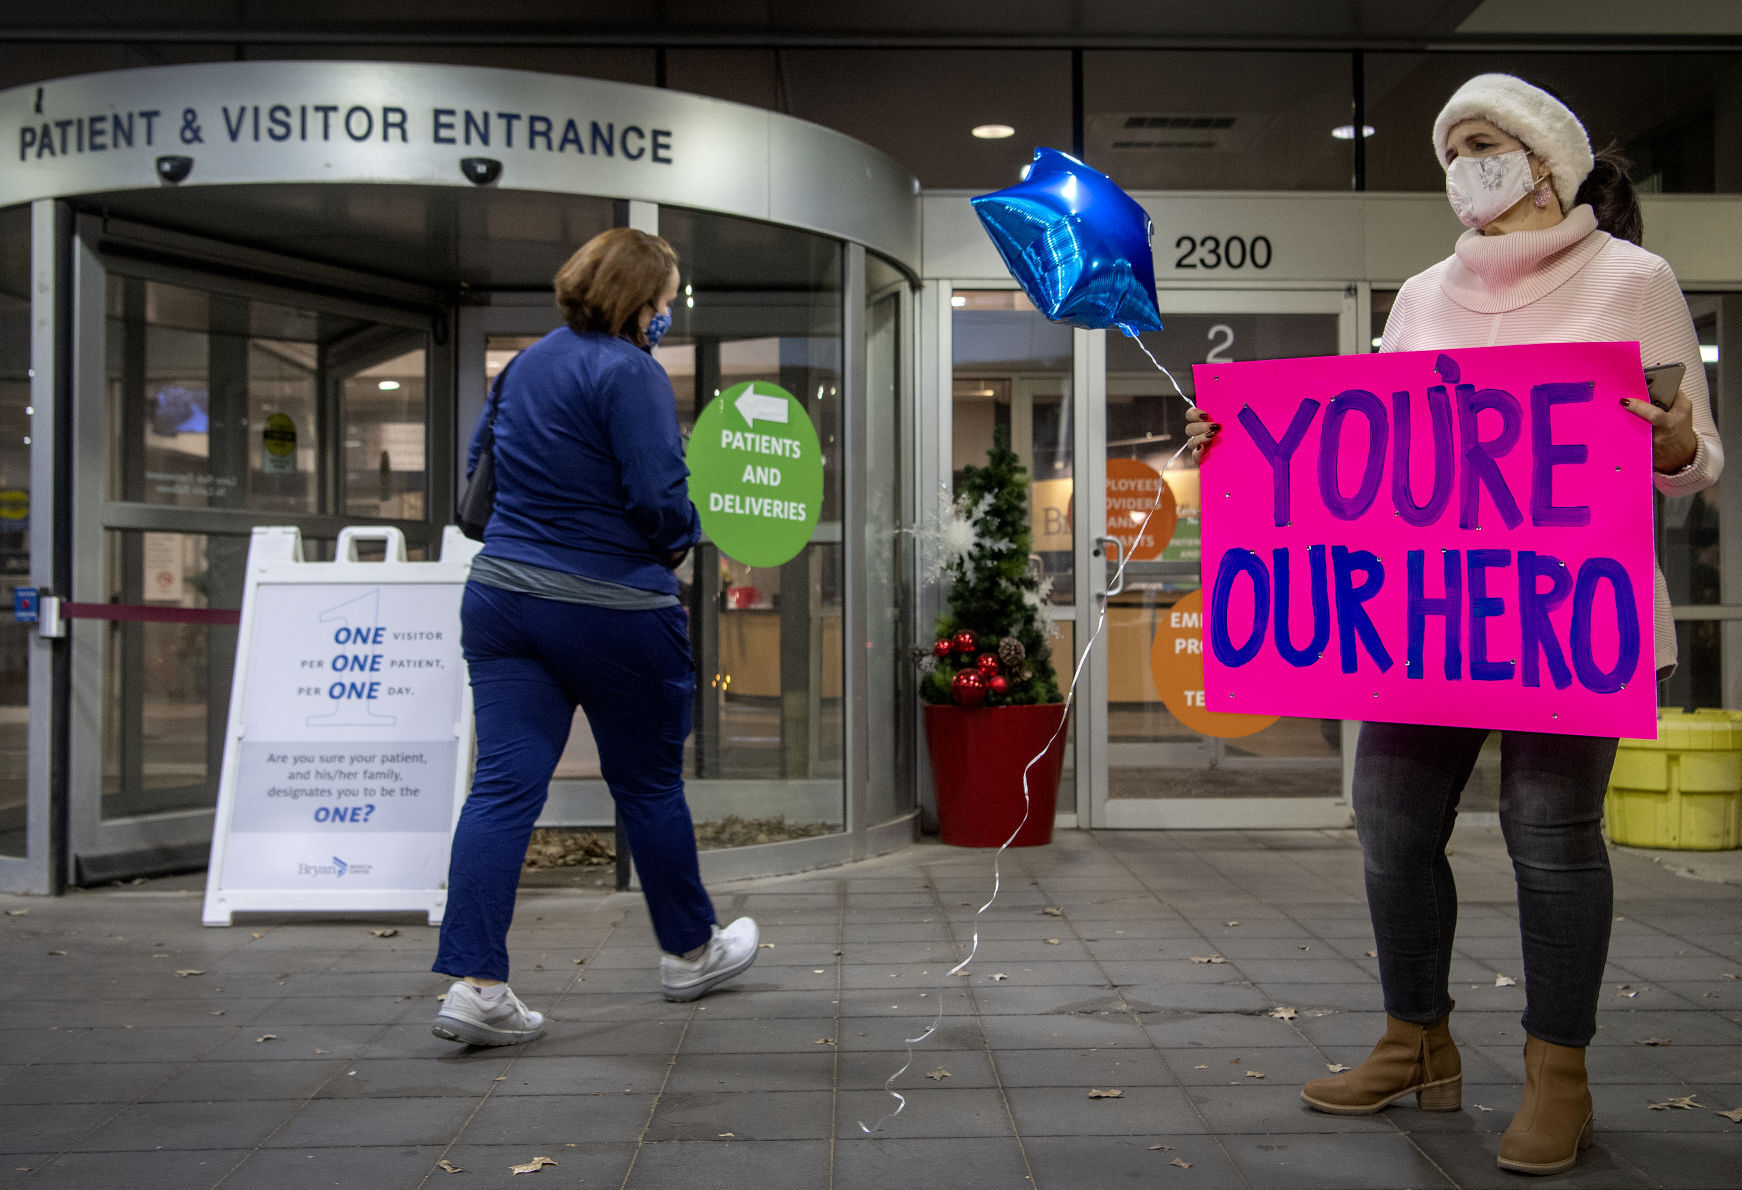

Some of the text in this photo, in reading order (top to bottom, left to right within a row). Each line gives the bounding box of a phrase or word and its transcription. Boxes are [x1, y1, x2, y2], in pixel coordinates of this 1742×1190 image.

[19, 104, 673, 165] PATIENT & VISITOR ENTRANCE
[1175, 235, 1272, 270] 2300
[1206, 324, 1235, 364] 2
[721, 429, 801, 459] PATIENTS
[1237, 354, 1594, 530] YOU'RE
[742, 464, 782, 487] AND
[1106, 478, 1165, 493] PLOYEES,
[709, 492, 807, 522] DELIVERIES
[1106, 497, 1163, 511] OVIDERS
[1211, 544, 1640, 694] OUR HERO
[334, 627, 443, 645] ONE VISITOR
[300, 654, 445, 672] PER ONE PATIENT,
[298, 681, 415, 700] PER ONE DAY.
[267, 752, 428, 766] Are you sure your patient,
[288, 769, 403, 783] and his/her family,
[267, 786, 420, 800] designates you to be the
[314, 804, 376, 823] ONE?
